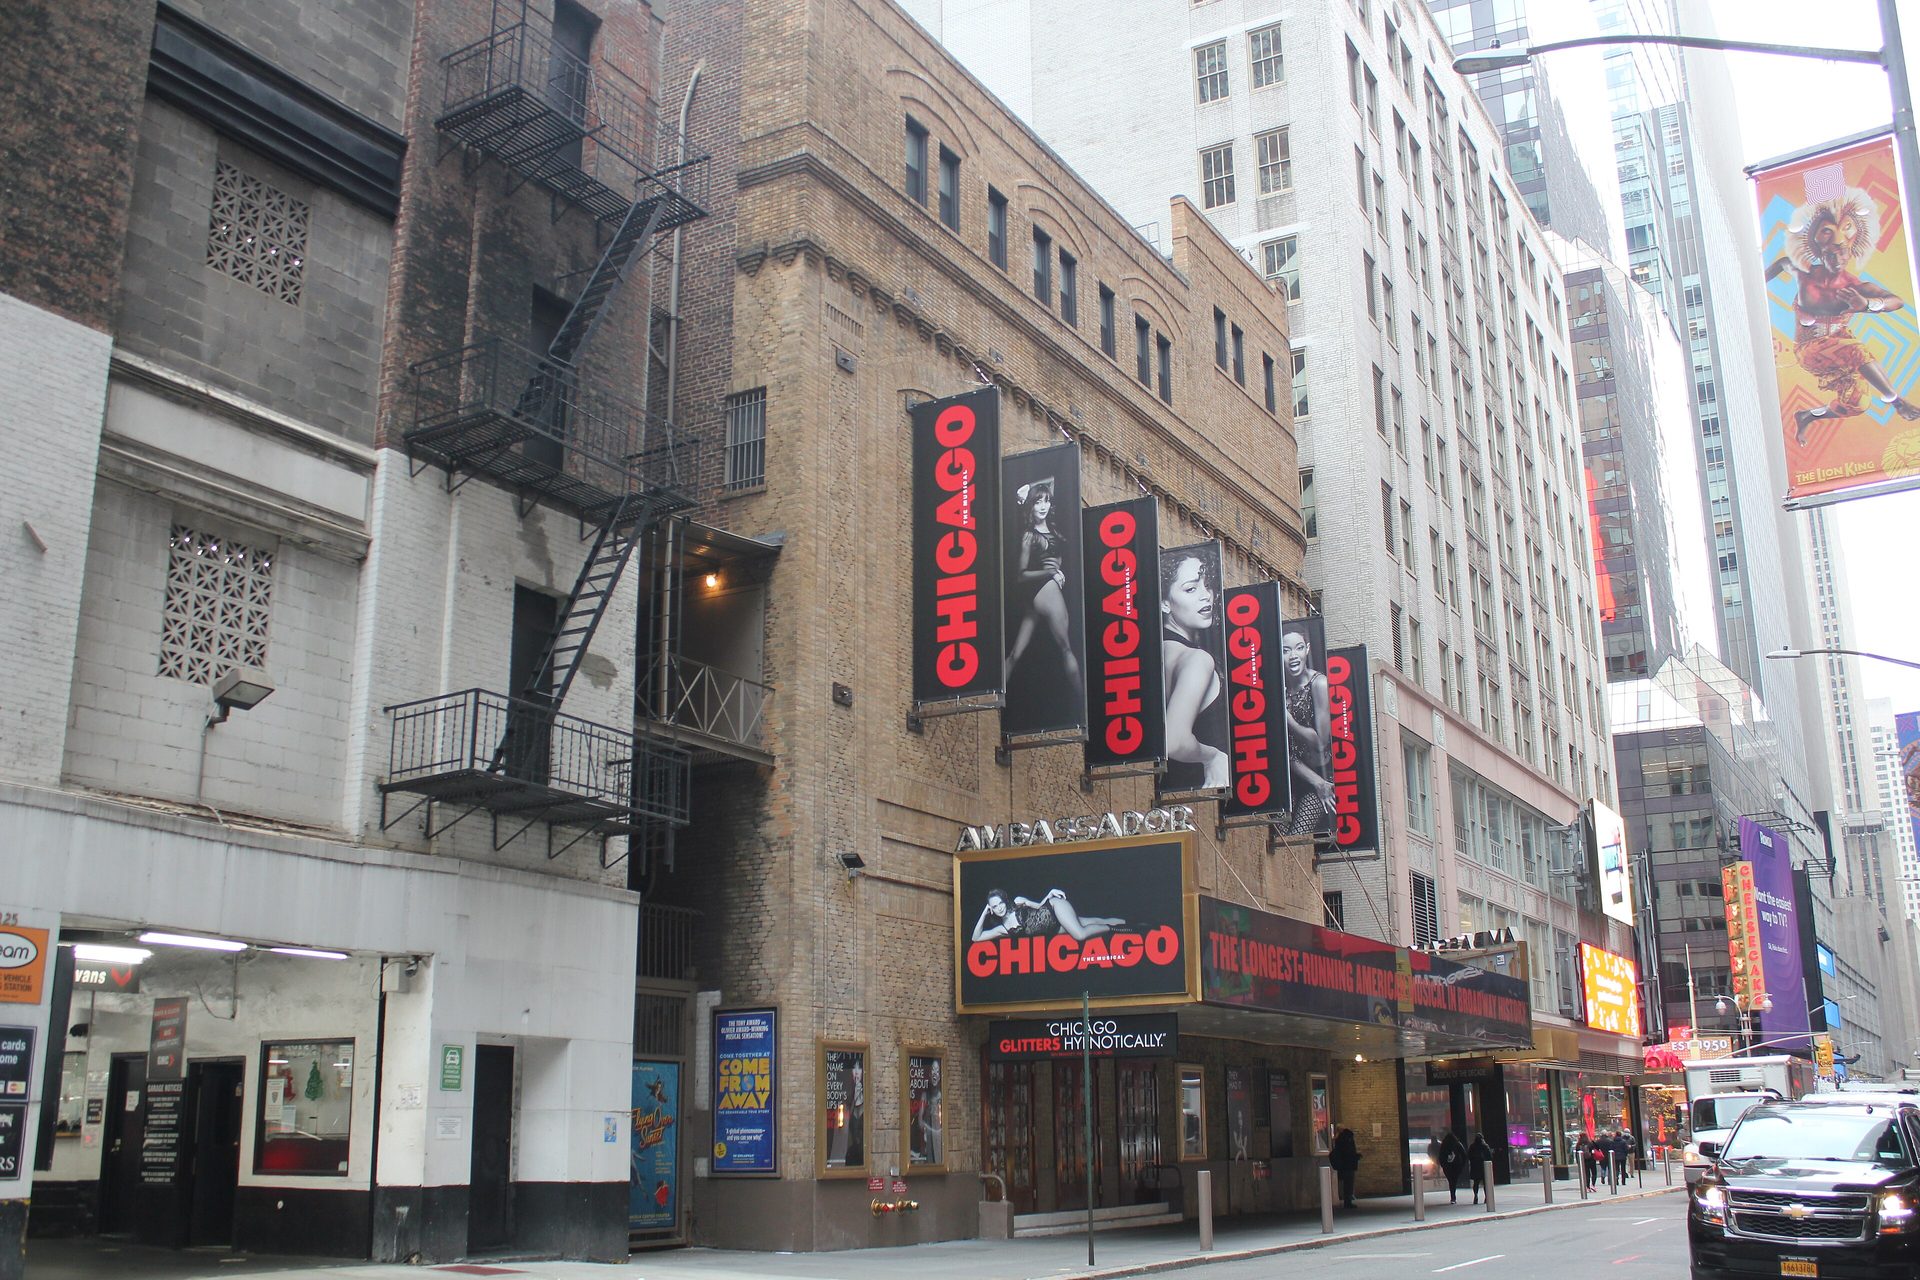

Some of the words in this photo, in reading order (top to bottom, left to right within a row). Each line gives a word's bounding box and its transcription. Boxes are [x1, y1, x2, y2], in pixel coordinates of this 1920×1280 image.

[1796, 471, 1815, 483] THE
[1817, 466, 1843, 482] LION
[1845, 461, 1874, 477] KING
[935, 404, 979, 688] CHICAGO
[1099, 510, 1143, 755] CHICAGO
[1227, 594, 1270, 806] CHICAGO
[1328, 656, 1360, 844] CHICAGO
[956, 805, 1196, 851] AMBASSADOR
[0, 913, 18, 926] 25
[1740, 865, 1763, 1005] CHEESECAKE
[0, 944, 29, 960] am
[967, 925, 1179, 978] CHICAGO
[4, 974, 32, 982] VEHICLE
[75, 970, 106, 984] vans
[1209, 932, 1239, 972] THE
[1242, 938, 1354, 992] LONGEST-RUNNING
[1356, 964, 1411, 1003] AMERICAN
[1412, 974, 1448, 1009] MUSICAL
[1448, 985, 1457, 1012] IN
[1458, 987, 1497, 1018] BROADWAY
[4, 983, 32, 992] STATION
[2, 1040, 26, 1050] cards
[1000, 1037, 1061, 1053] GLITTERS
[827, 1053, 836, 1062] THE
[910, 1058, 918, 1068] ALL
[720, 1058, 770, 1075] COME
[826, 1063, 844, 1071] NAME
[826, 1072, 836, 1080] ON
[910, 1069, 924, 1079] CARE
[826, 1082, 844, 1091] EVERY
[910, 1080, 929, 1089] ABOUT
[719, 1092, 770, 1109] AWAY
[826, 1091, 847, 1100] BODY'S
[910, 1089, 915, 1099] IS
[826, 1101, 837, 1110] LIPS
